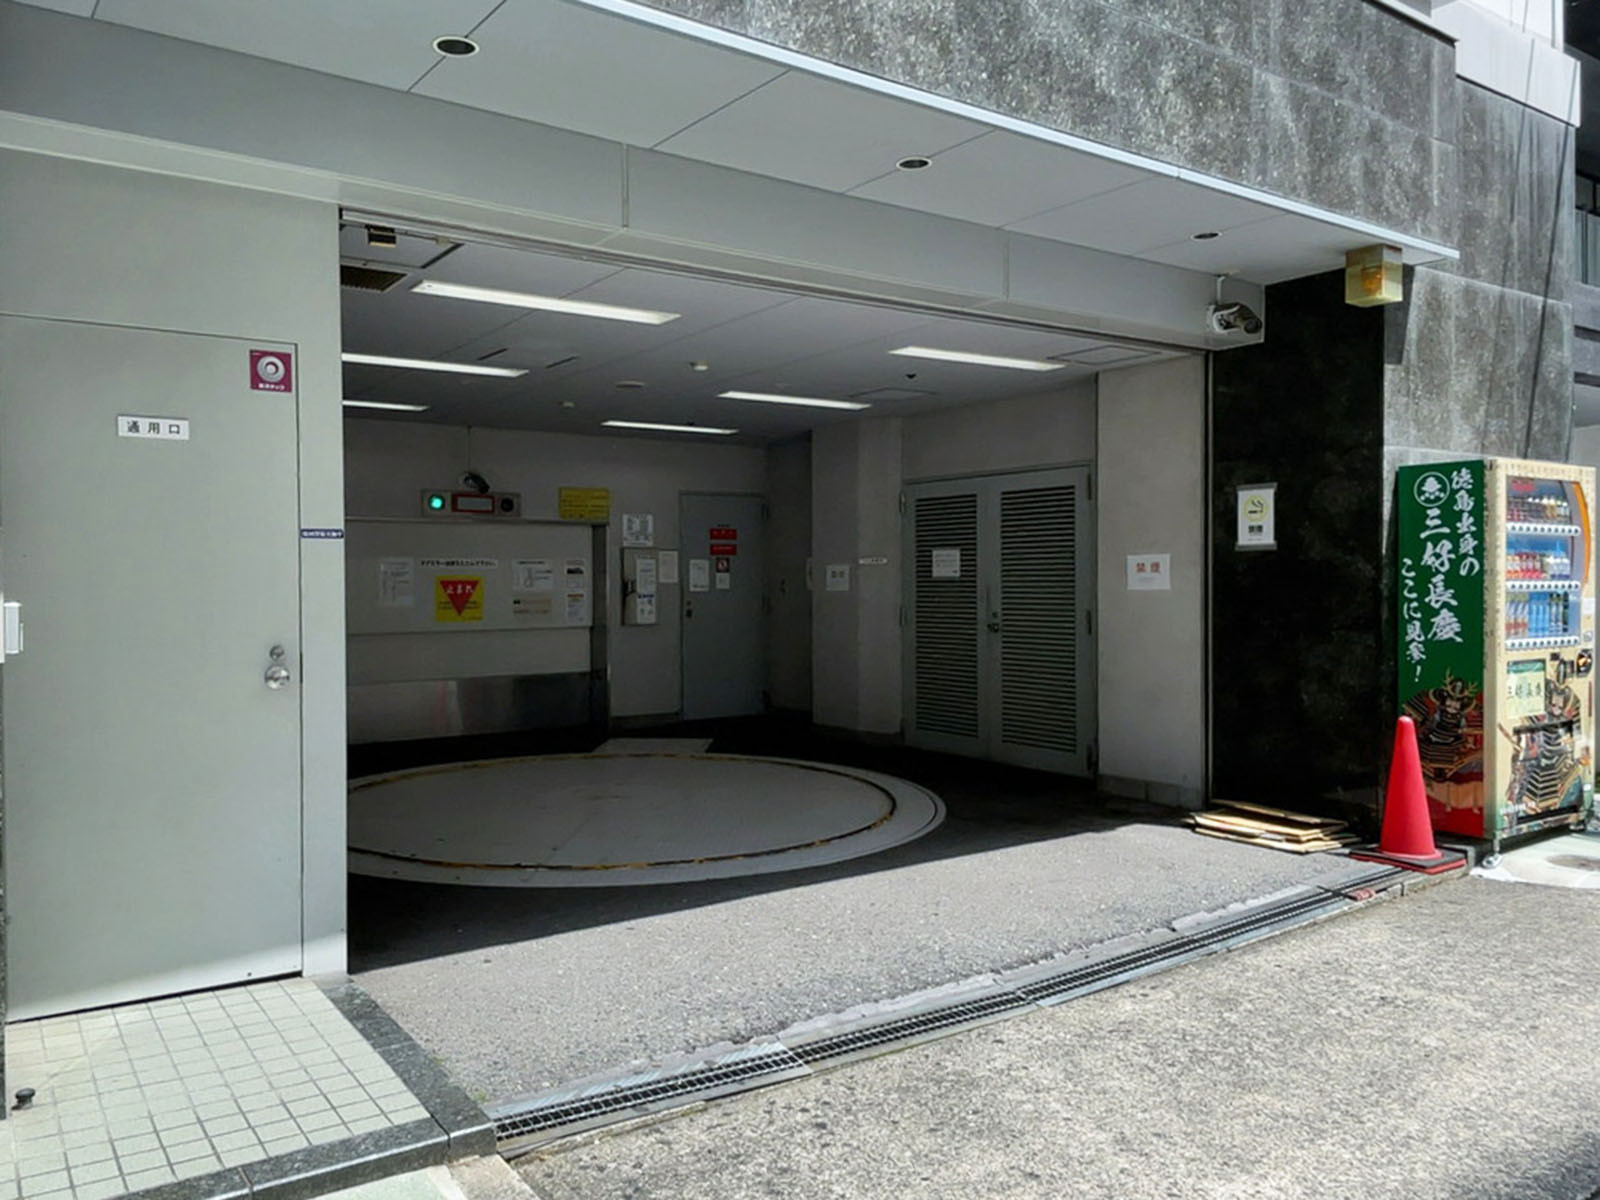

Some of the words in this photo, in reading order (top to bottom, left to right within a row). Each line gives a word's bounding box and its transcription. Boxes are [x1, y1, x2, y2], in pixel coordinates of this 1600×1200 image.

[127, 420, 181, 436] 通用口
[1419, 507, 1464, 643] 三好長慶
[1451, 467, 1480, 577] 徳島出身の
